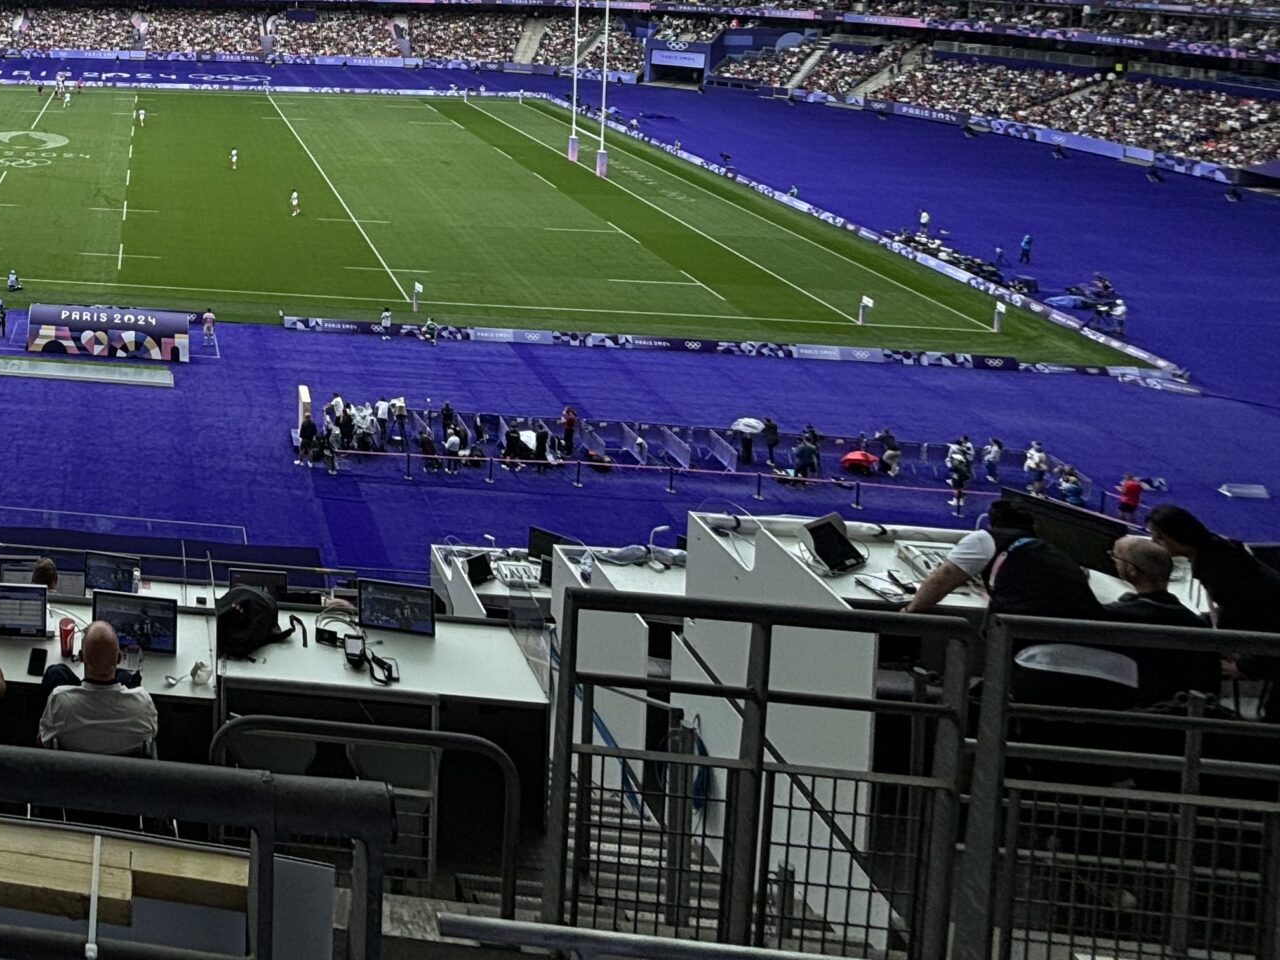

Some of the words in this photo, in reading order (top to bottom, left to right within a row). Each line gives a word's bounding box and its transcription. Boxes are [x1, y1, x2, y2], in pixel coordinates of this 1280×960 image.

[902, 106, 929, 117] PARIS
[931, 111, 956, 122] 2024
[25, 151, 91, 159] 2024
[61, 310, 107, 322] PARIS
[113, 314, 156, 325] 2024
